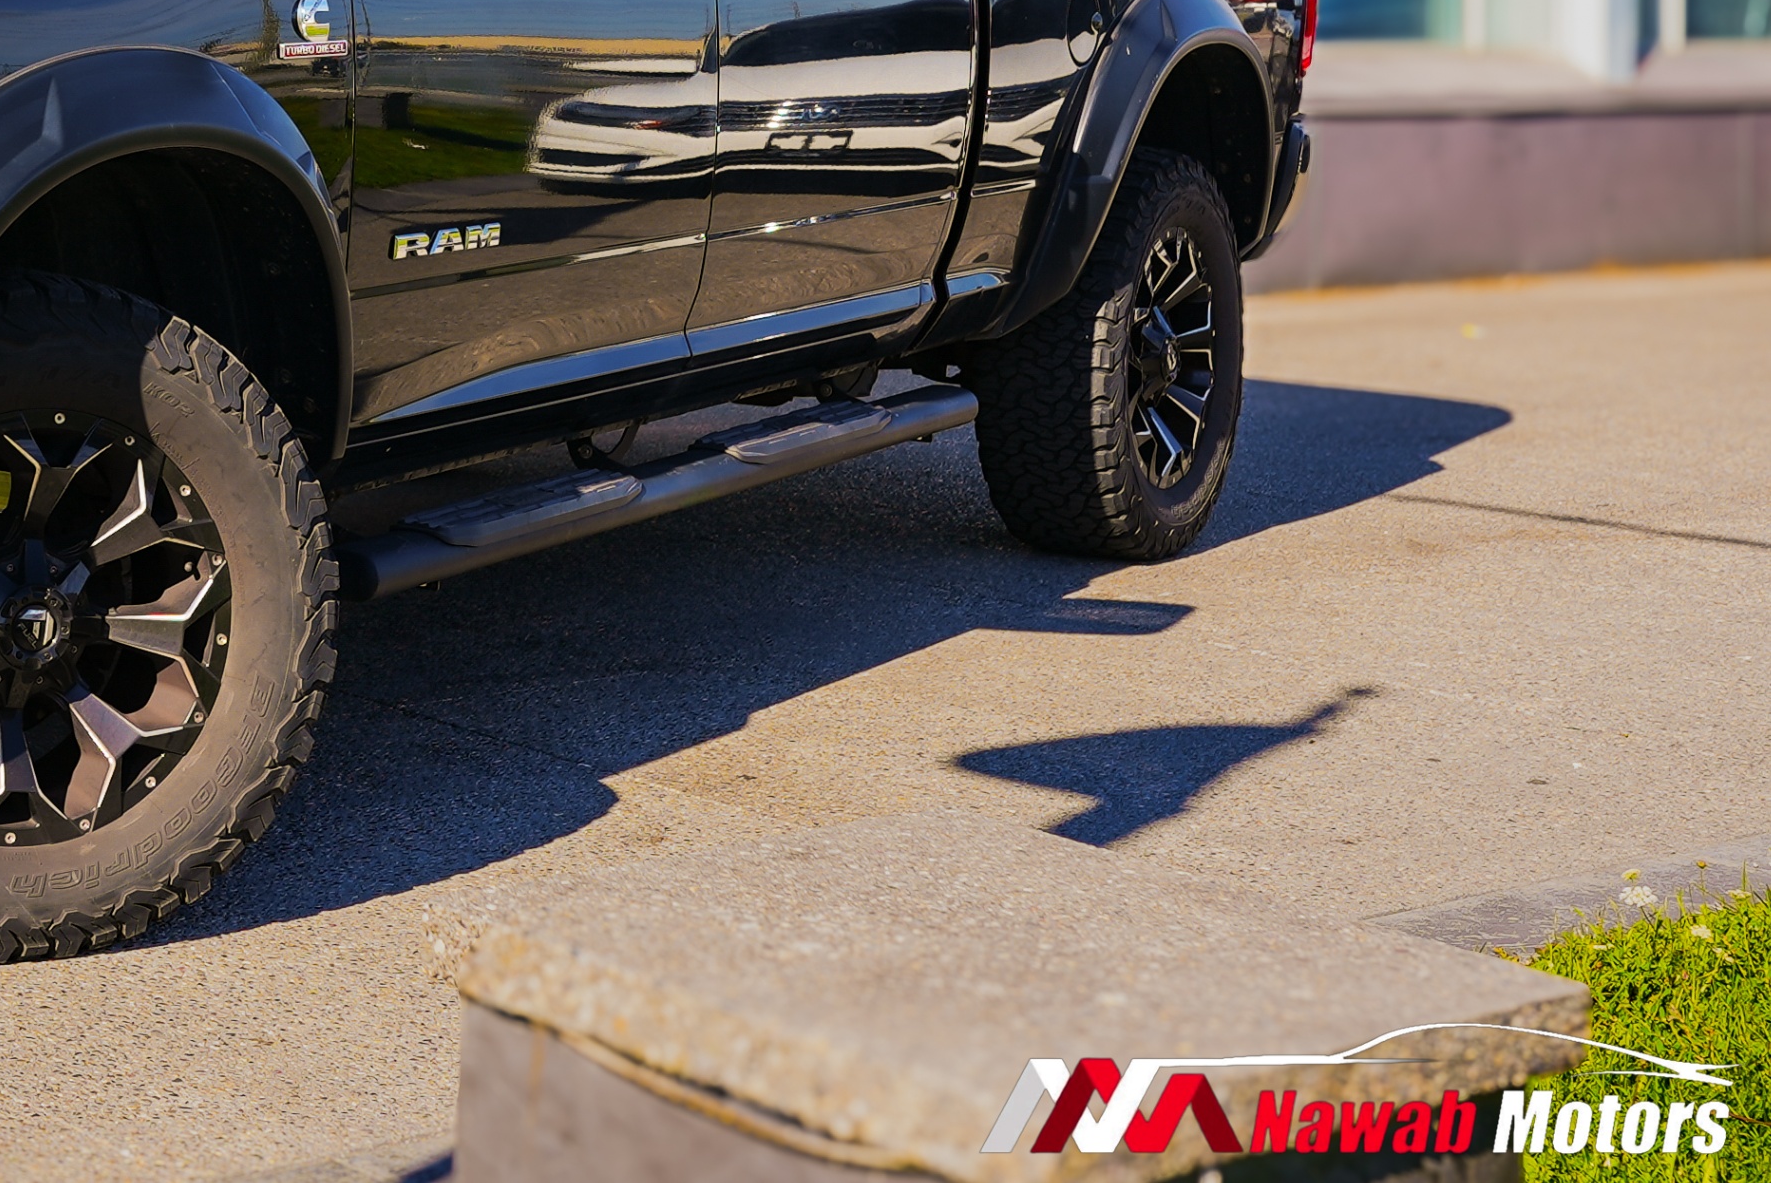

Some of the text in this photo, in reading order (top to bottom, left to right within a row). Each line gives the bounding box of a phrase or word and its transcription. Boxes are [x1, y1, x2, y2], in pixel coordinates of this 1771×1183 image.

[285, 43, 346, 56] TURBO DIESEL
[392, 221, 501, 260] RAM
[16, 621, 38, 651] FUEL
